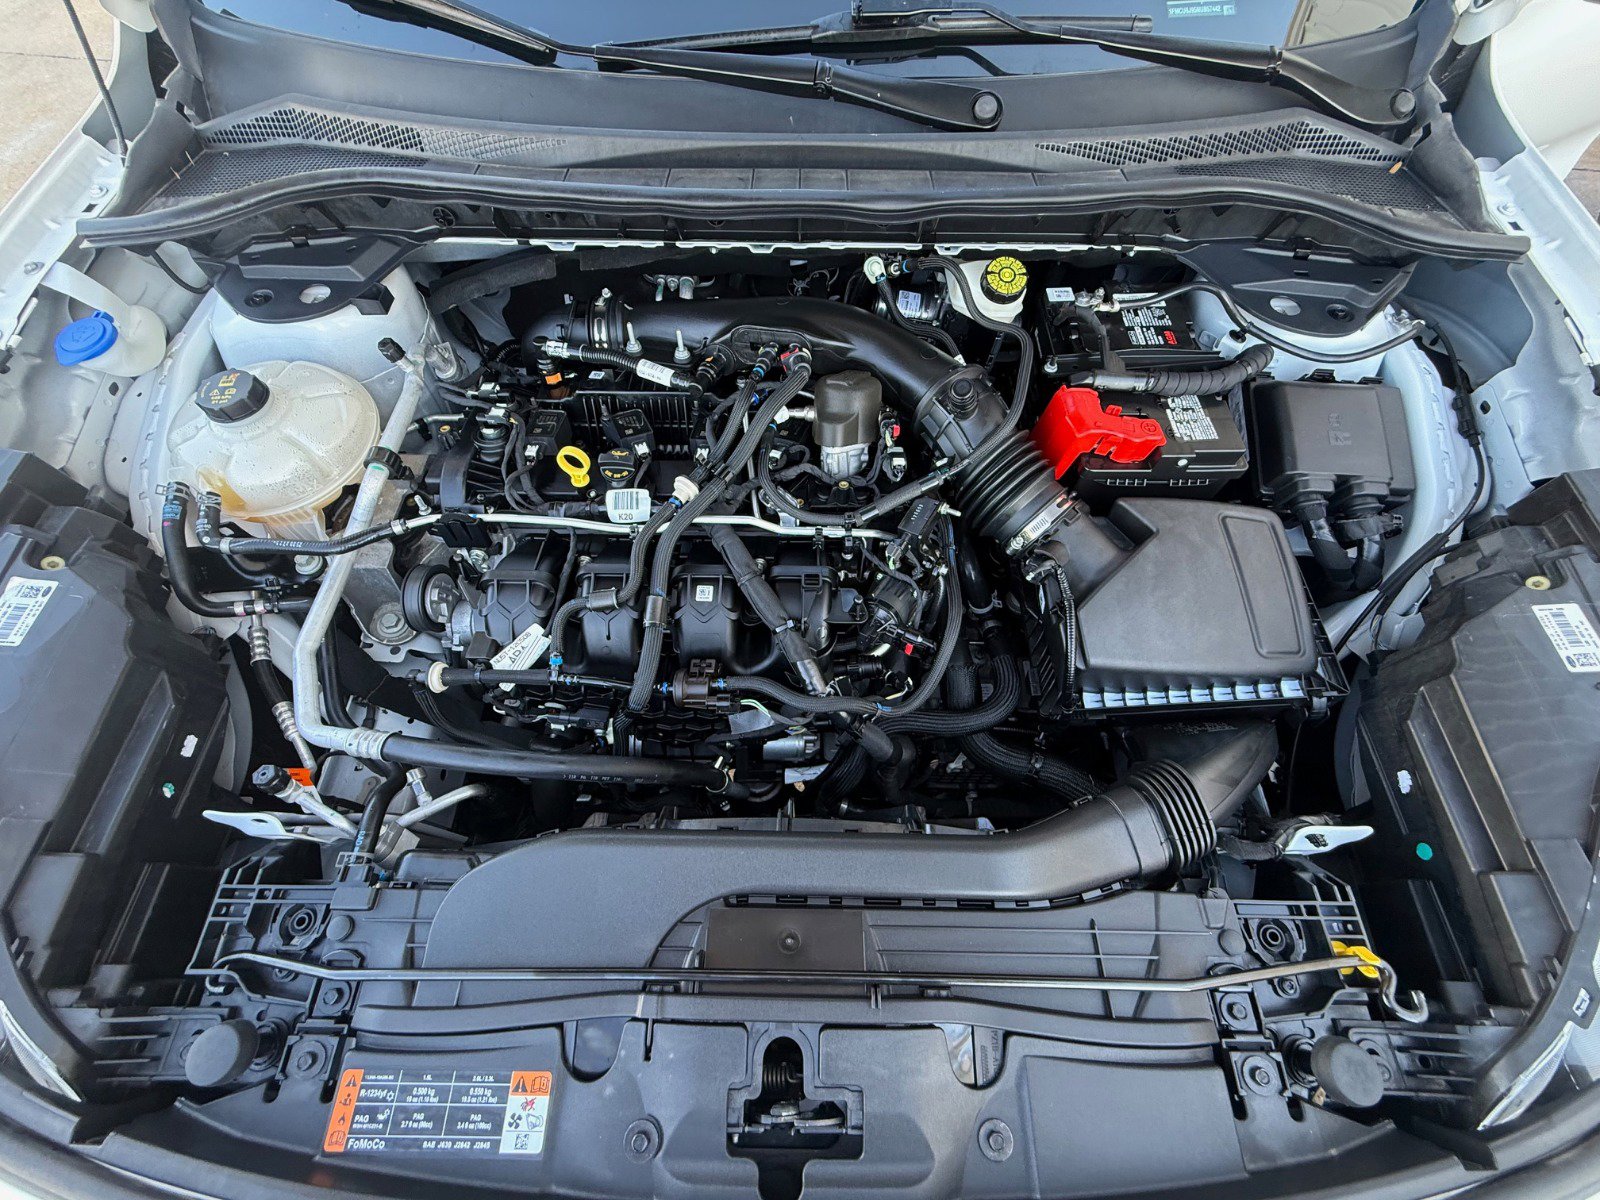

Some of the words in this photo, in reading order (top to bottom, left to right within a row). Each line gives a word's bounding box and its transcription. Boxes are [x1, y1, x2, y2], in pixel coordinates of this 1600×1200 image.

[618, 513, 634, 521] K20
[359, 1087, 387, 1100] R-1234yf
[347, 1139, 386, 1150] FoMoCo
